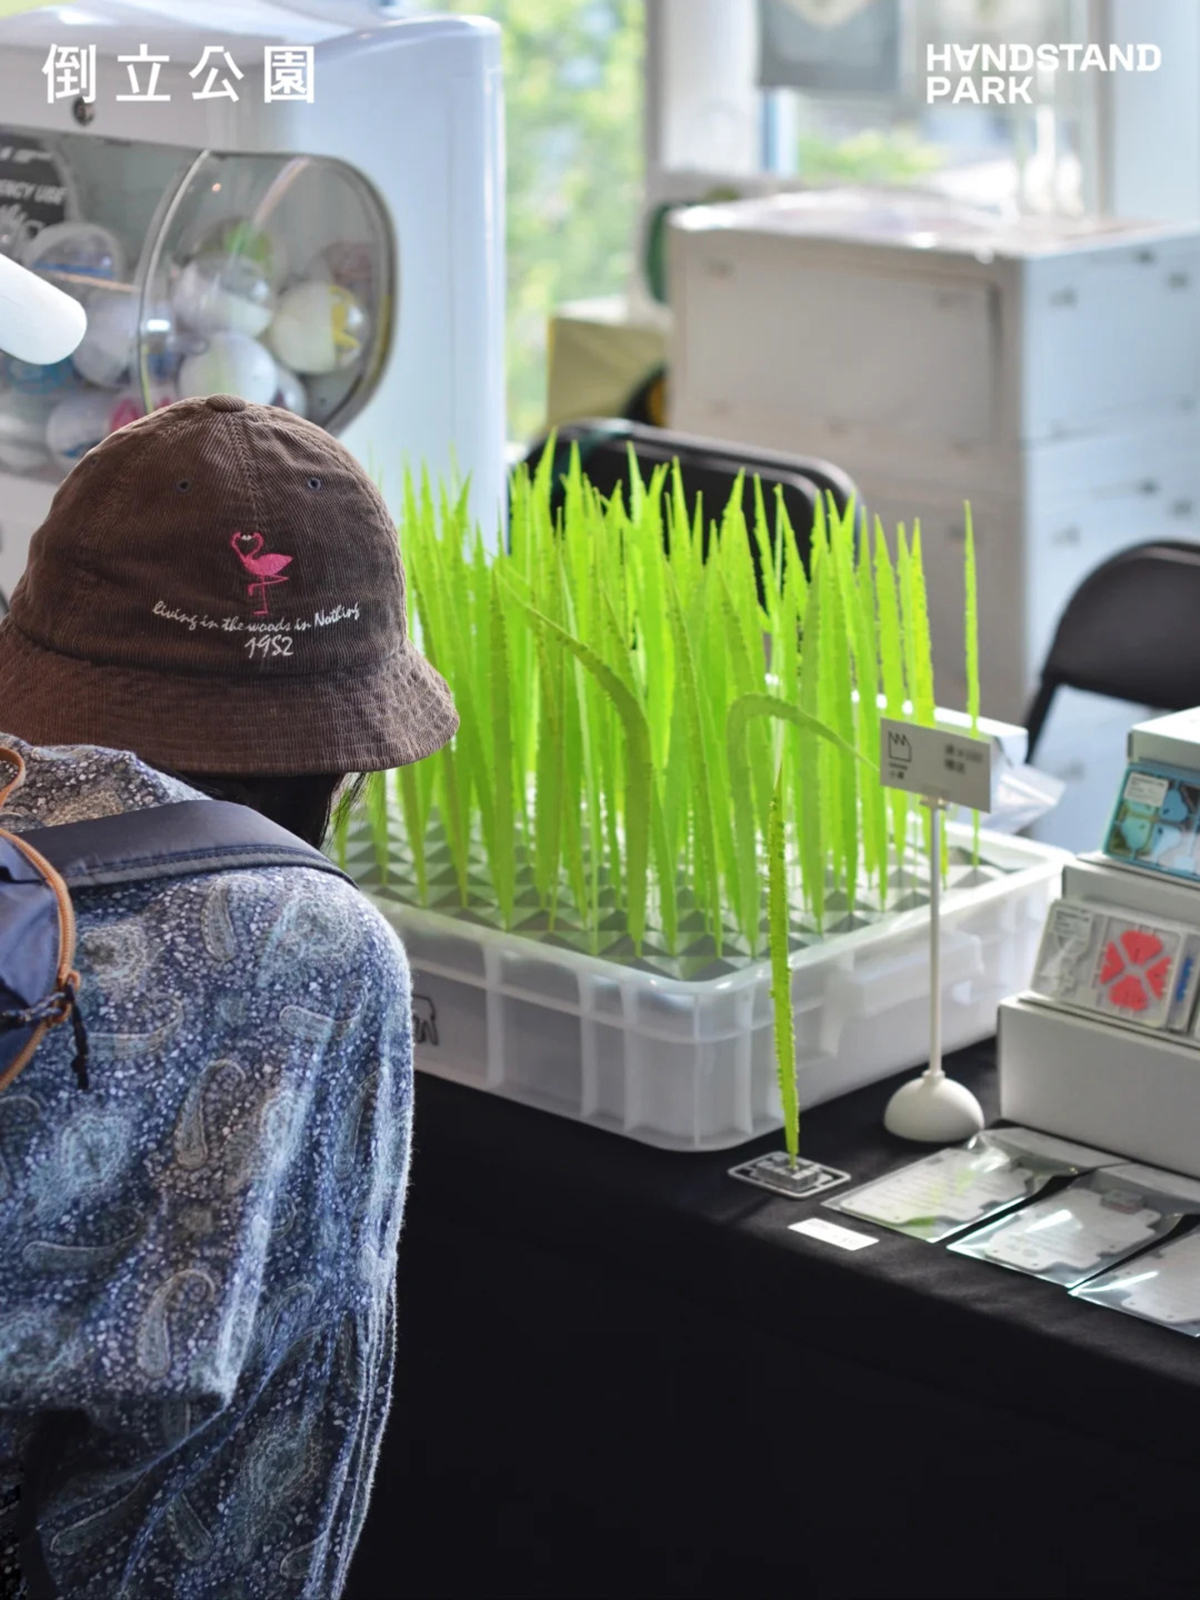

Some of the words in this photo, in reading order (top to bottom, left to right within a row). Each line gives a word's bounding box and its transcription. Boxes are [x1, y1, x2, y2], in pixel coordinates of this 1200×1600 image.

[200, 615, 219, 630] in
[222, 616, 244, 632] the
[294, 618, 312, 632] in
[244, 634, 294, 659] 1952
